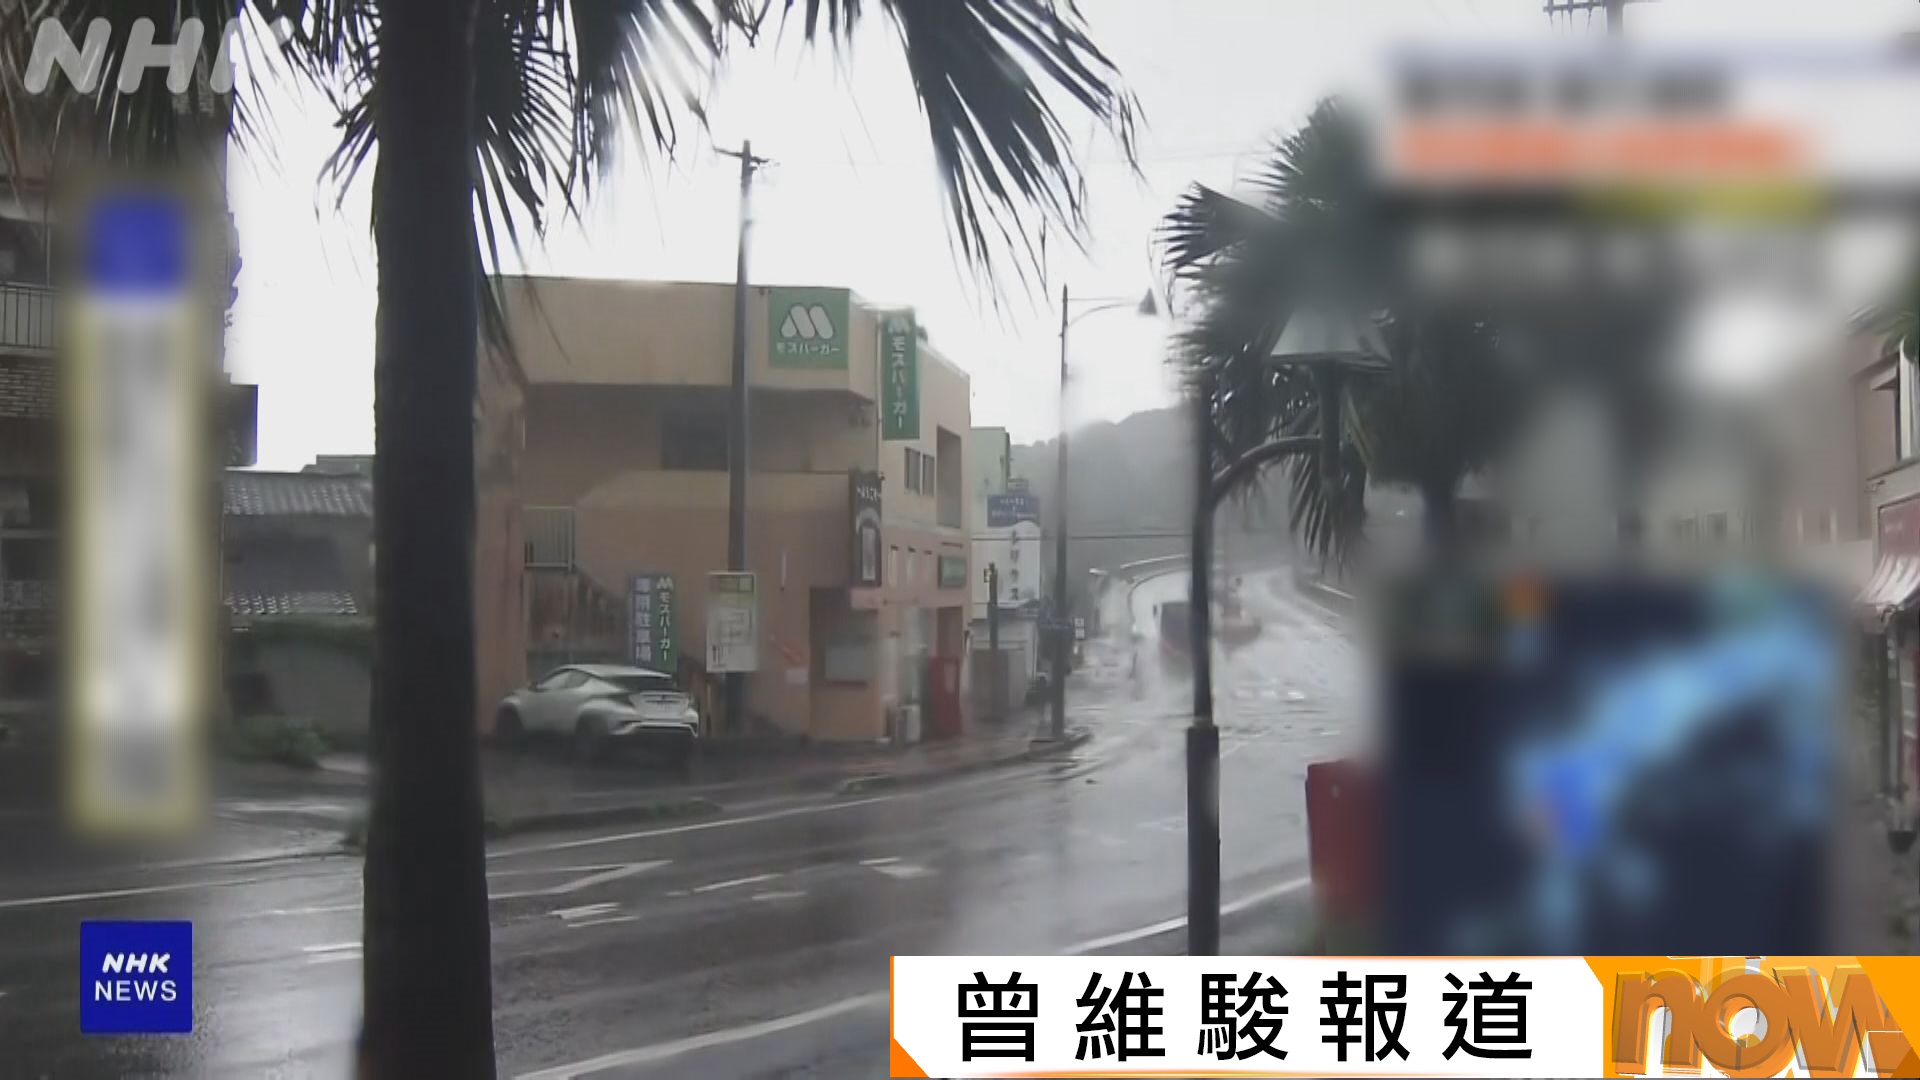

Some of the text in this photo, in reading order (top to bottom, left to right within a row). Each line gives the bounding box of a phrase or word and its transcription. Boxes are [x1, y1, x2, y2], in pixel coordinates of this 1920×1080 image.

[776, 341, 841, 356] モスバーガー
